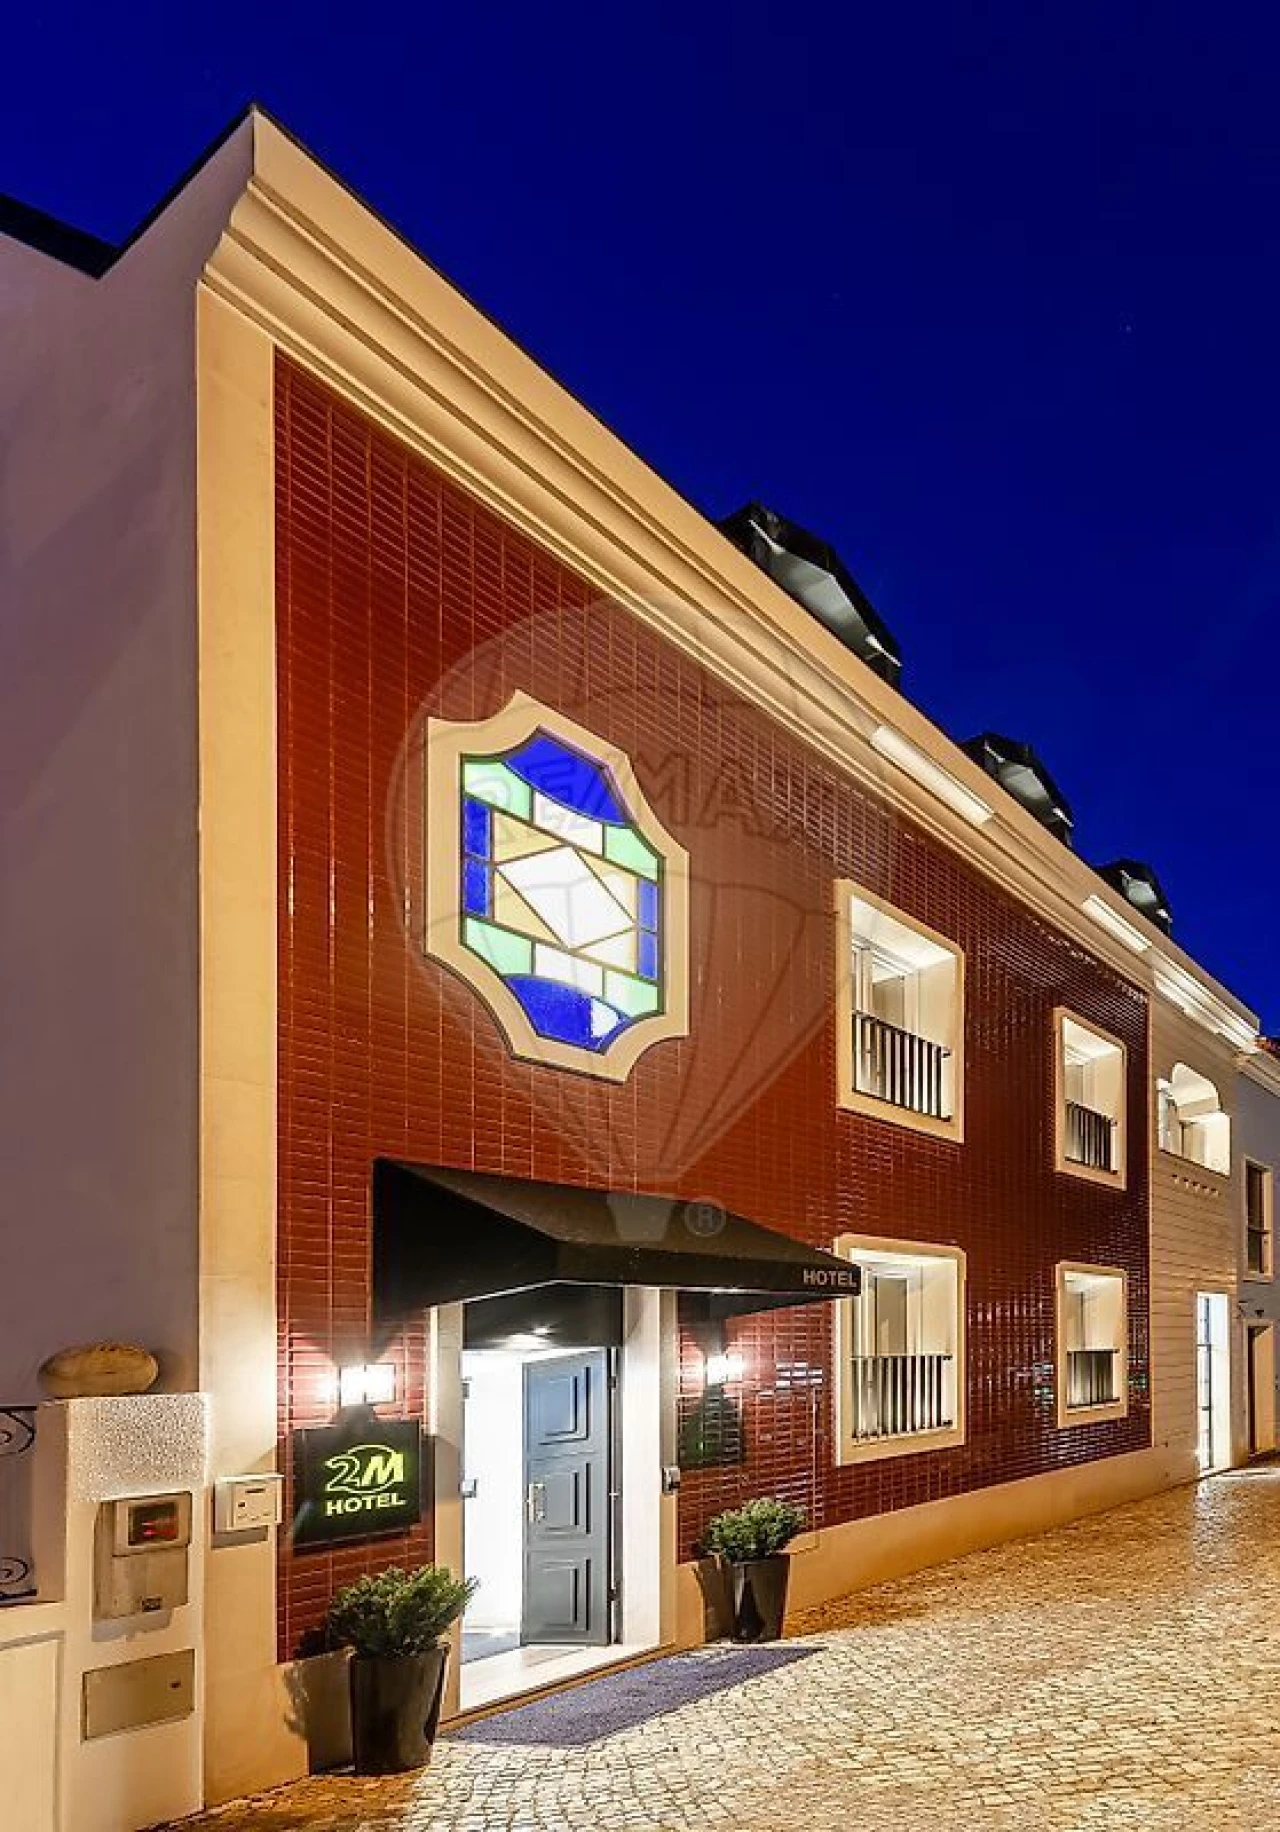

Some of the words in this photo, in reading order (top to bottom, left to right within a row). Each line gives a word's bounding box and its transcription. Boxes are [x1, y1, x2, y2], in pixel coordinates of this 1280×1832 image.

[803, 1268, 857, 1288] HOTEL
[325, 1445, 404, 1493] 2M
[325, 1493, 406, 1516] HOTEL
